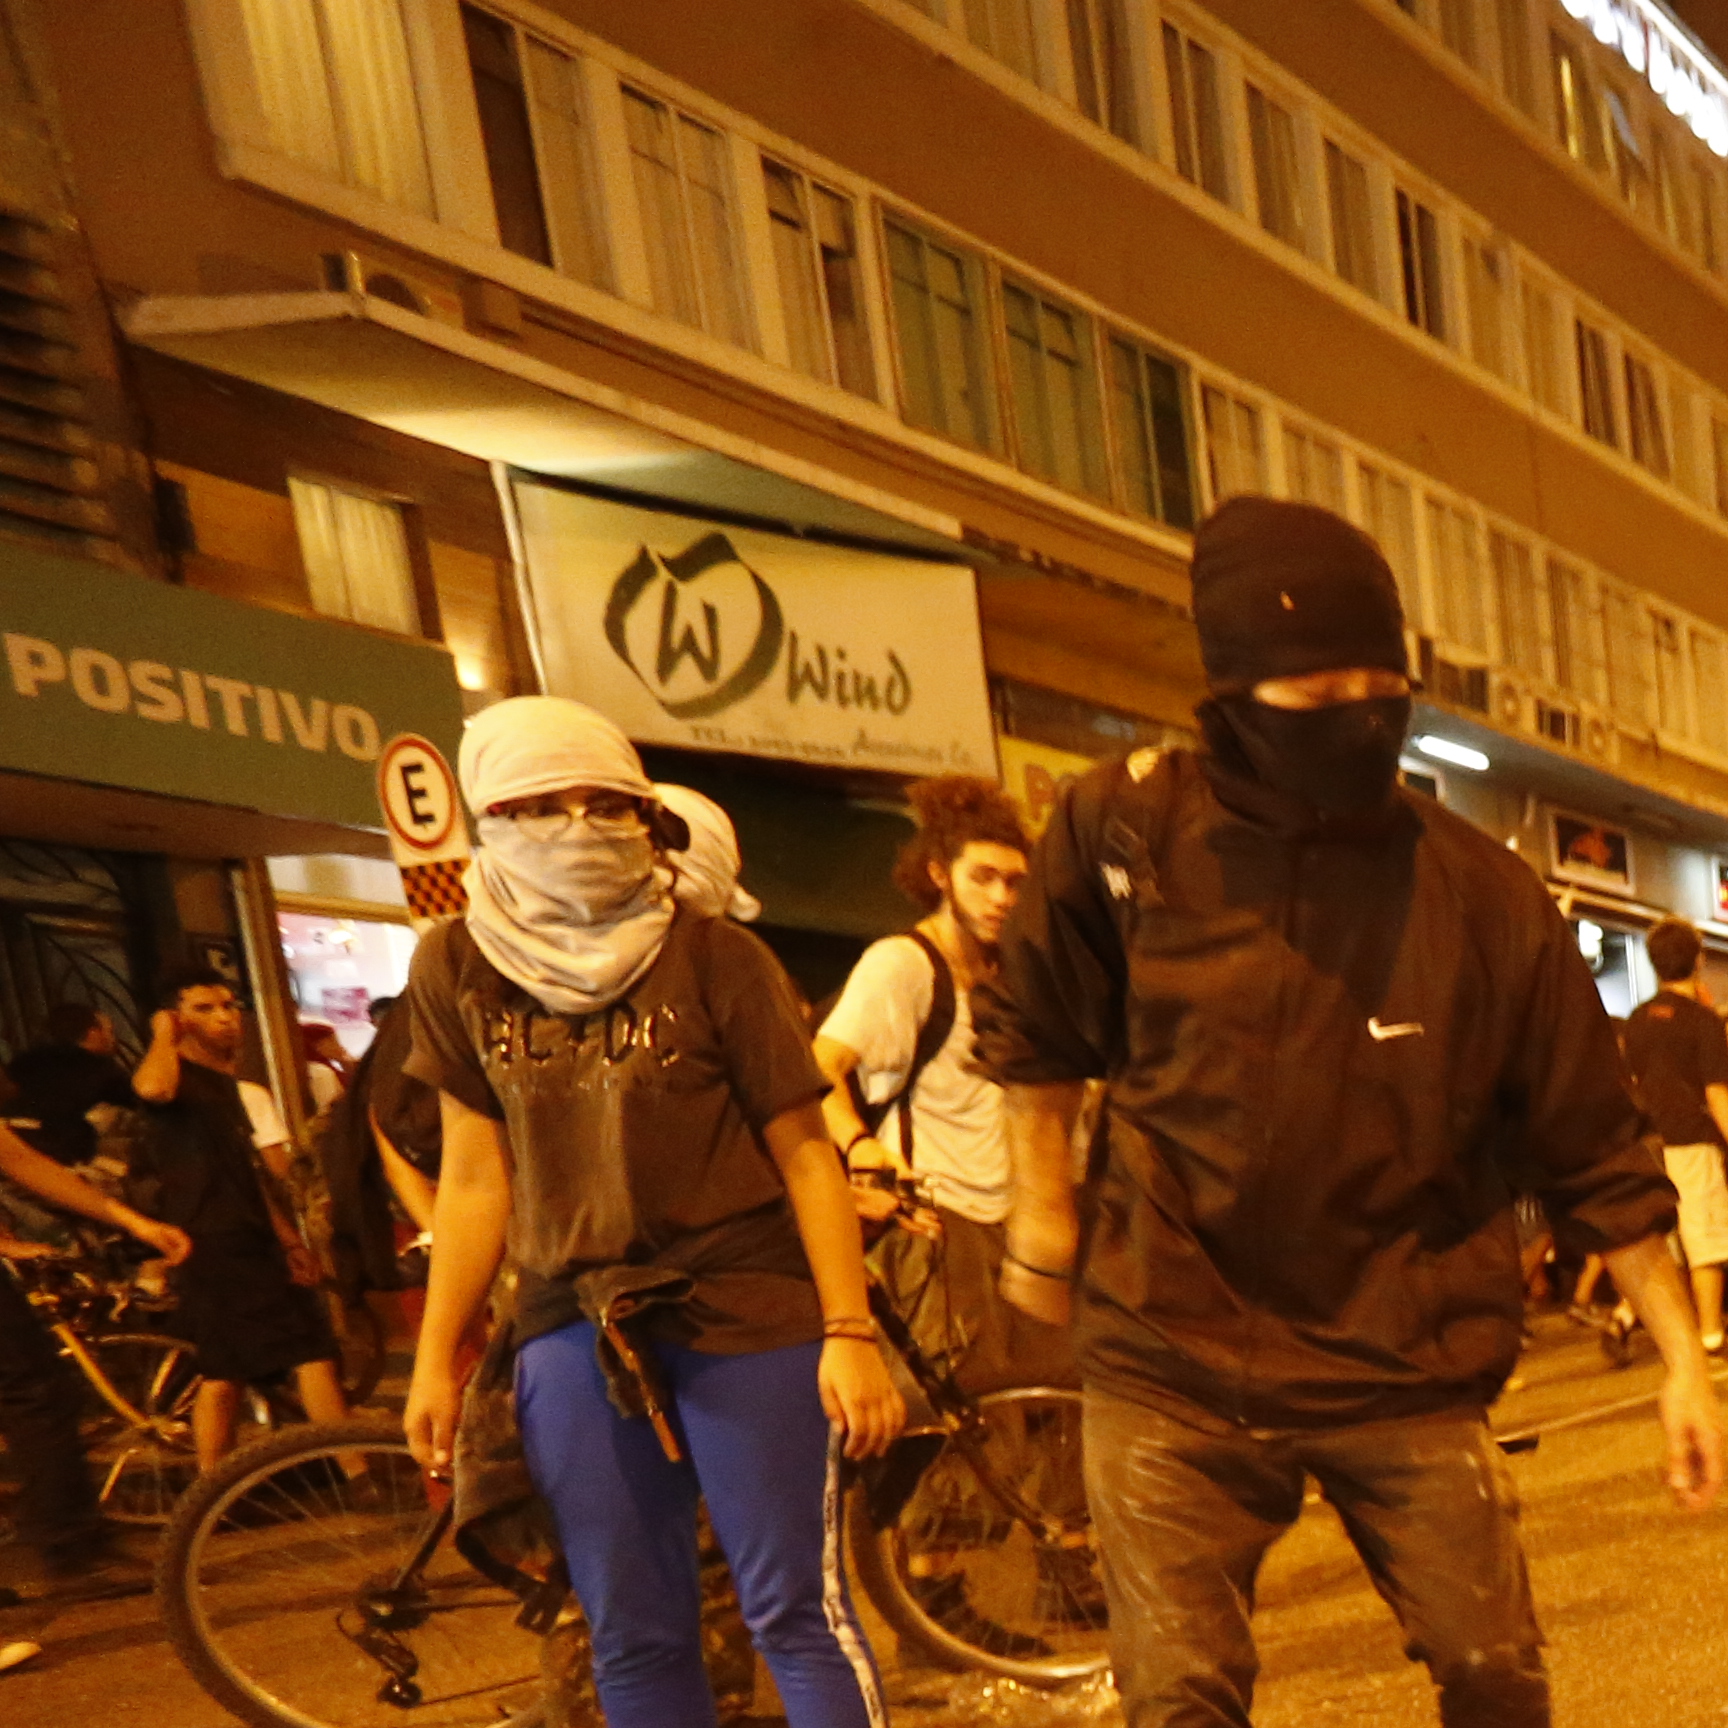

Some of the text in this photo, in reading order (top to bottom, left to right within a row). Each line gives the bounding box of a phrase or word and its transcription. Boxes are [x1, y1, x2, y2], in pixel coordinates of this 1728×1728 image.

[3, 632, 382, 762] POSITIVO
[785, 628, 912, 716] Wind
[400, 762, 436, 826] E
